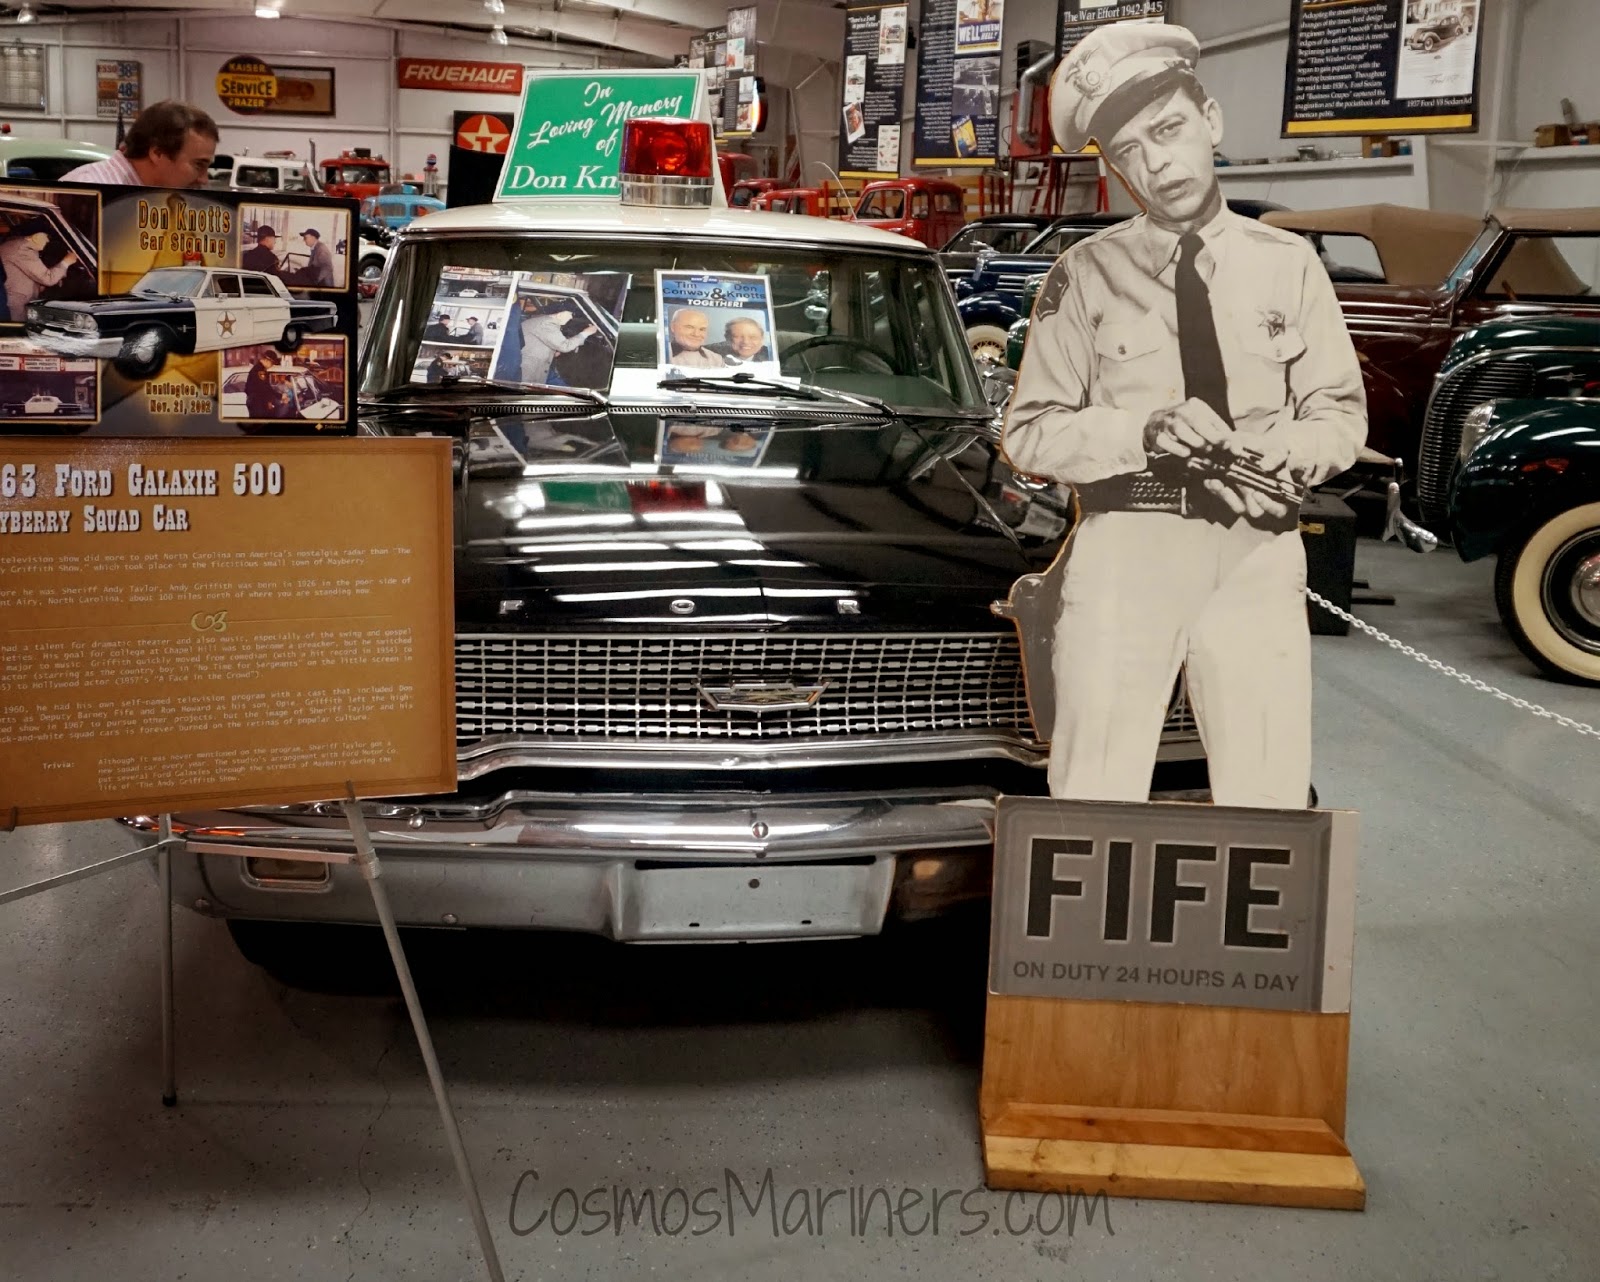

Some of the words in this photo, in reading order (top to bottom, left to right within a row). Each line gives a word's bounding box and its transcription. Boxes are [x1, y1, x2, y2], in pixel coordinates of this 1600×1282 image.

[1064, 11, 1078, 22] The
[1079, 10, 1095, 20] War
[1097, 8, 1120, 19] Effort
[1122, 1, 1163, 16] 1942-1945
[959, 25, 980, 41] WE'LL
[229, 63, 266, 72] KAISER
[404, 64, 518, 83] FRUEHAUF
[118, 83, 132, 96] 48
[221, 78, 272, 95] SERVICE
[584, 81, 614, 107] In
[228, 98, 265, 106] FRAZER
[526, 118, 598, 150] Loving
[600, 95, 683, 128] Memory
[596, 128, 619, 157] of
[508, 165, 567, 189] Don
[138, 200, 169, 230] Don
[177, 202, 230, 233] Knotts
[140, 231, 164, 250] Car
[170, 232, 226, 258] Signing
[662, 288, 710, 297] Conway
[710, 287, 726, 300] &
[675, 281, 697, 289] Tim
[734, 284, 757, 292] Don
[687, 299, 743, 307] TOGETHER!
[726, 290, 766, 299] Knotts
[145, 381, 198, 398] Huntington,
[150, 399, 170, 413] Nov.
[232, 462, 281, 496] 500
[1025, 836, 1293, 950] FIFE
[1013, 961, 1044, 979] ON
[1052, 963, 1110, 982] DUTY
[1116, 966, 1140, 984] 24
[1147, 968, 1224, 987] HOURS
[1231, 972, 1247, 990] A
[1255, 973, 1300, 993] DAY
